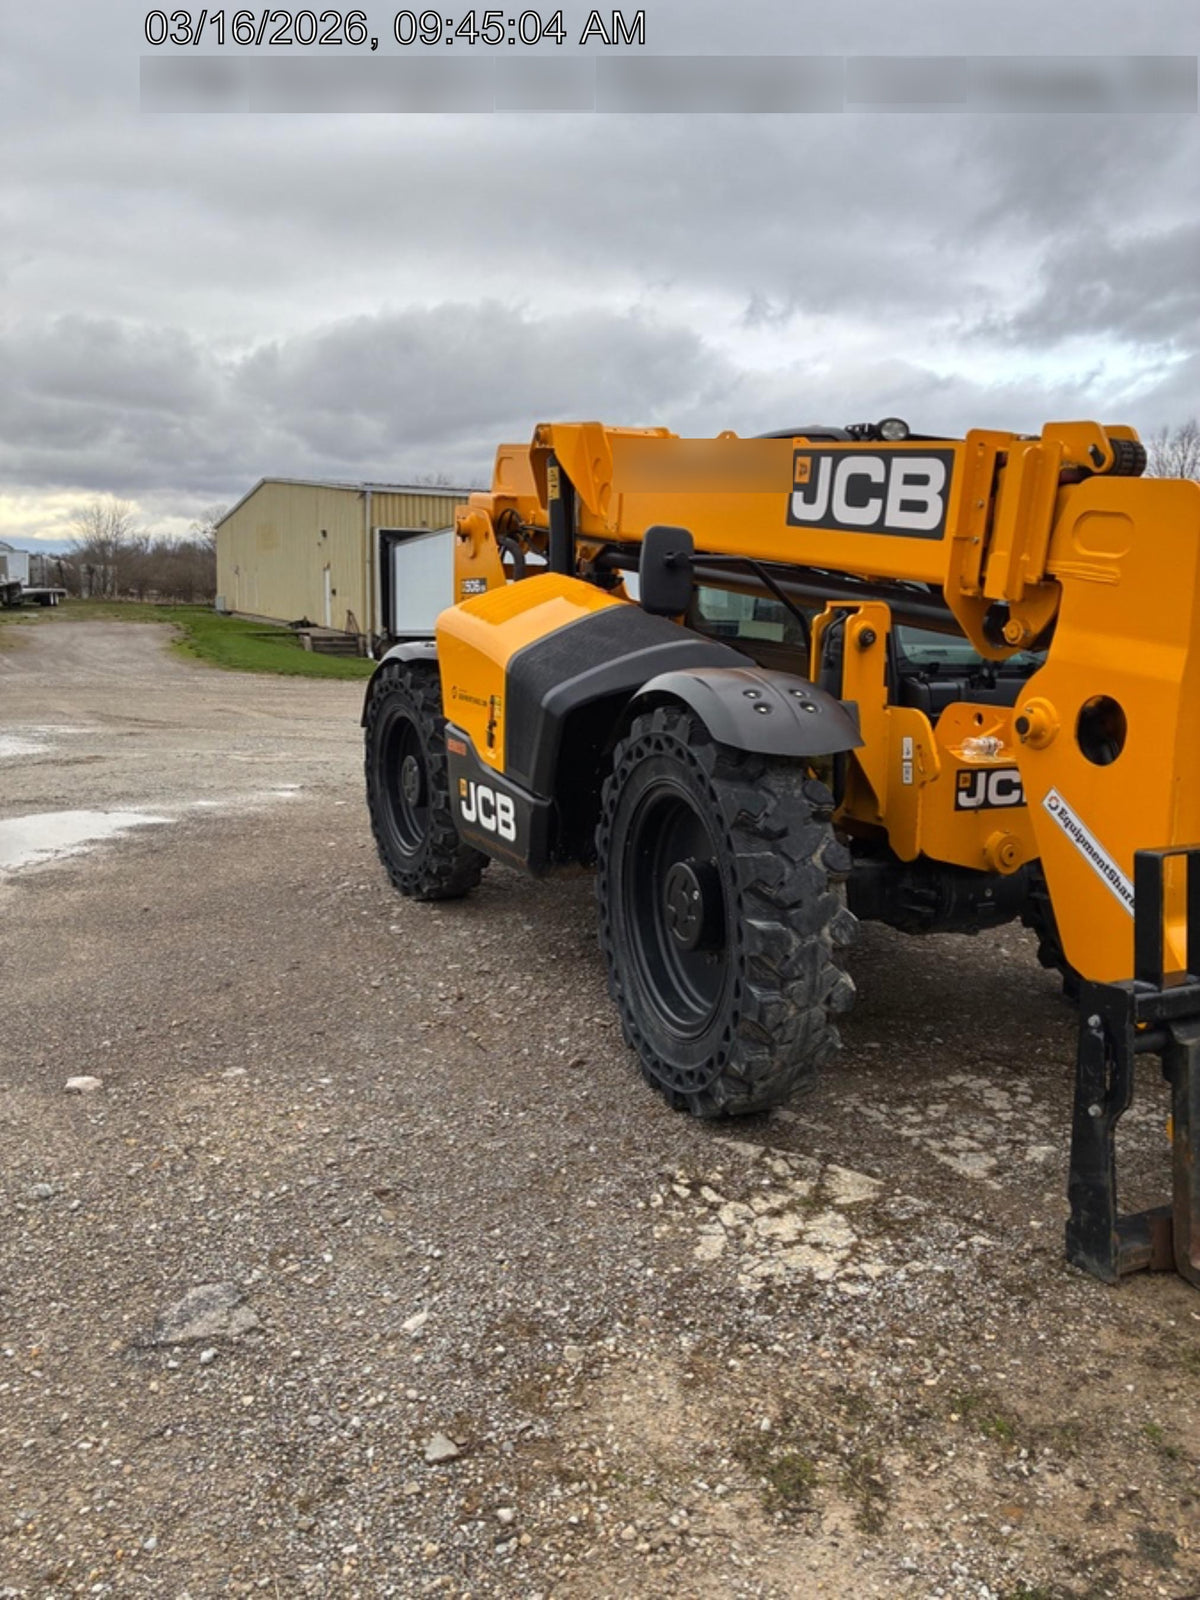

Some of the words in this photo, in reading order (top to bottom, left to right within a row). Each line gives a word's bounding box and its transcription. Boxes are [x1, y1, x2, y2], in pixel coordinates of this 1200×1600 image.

[791, 455, 946, 531] JCB
[460, 781, 517, 843] JCB
[957, 769, 1028, 808] JC
